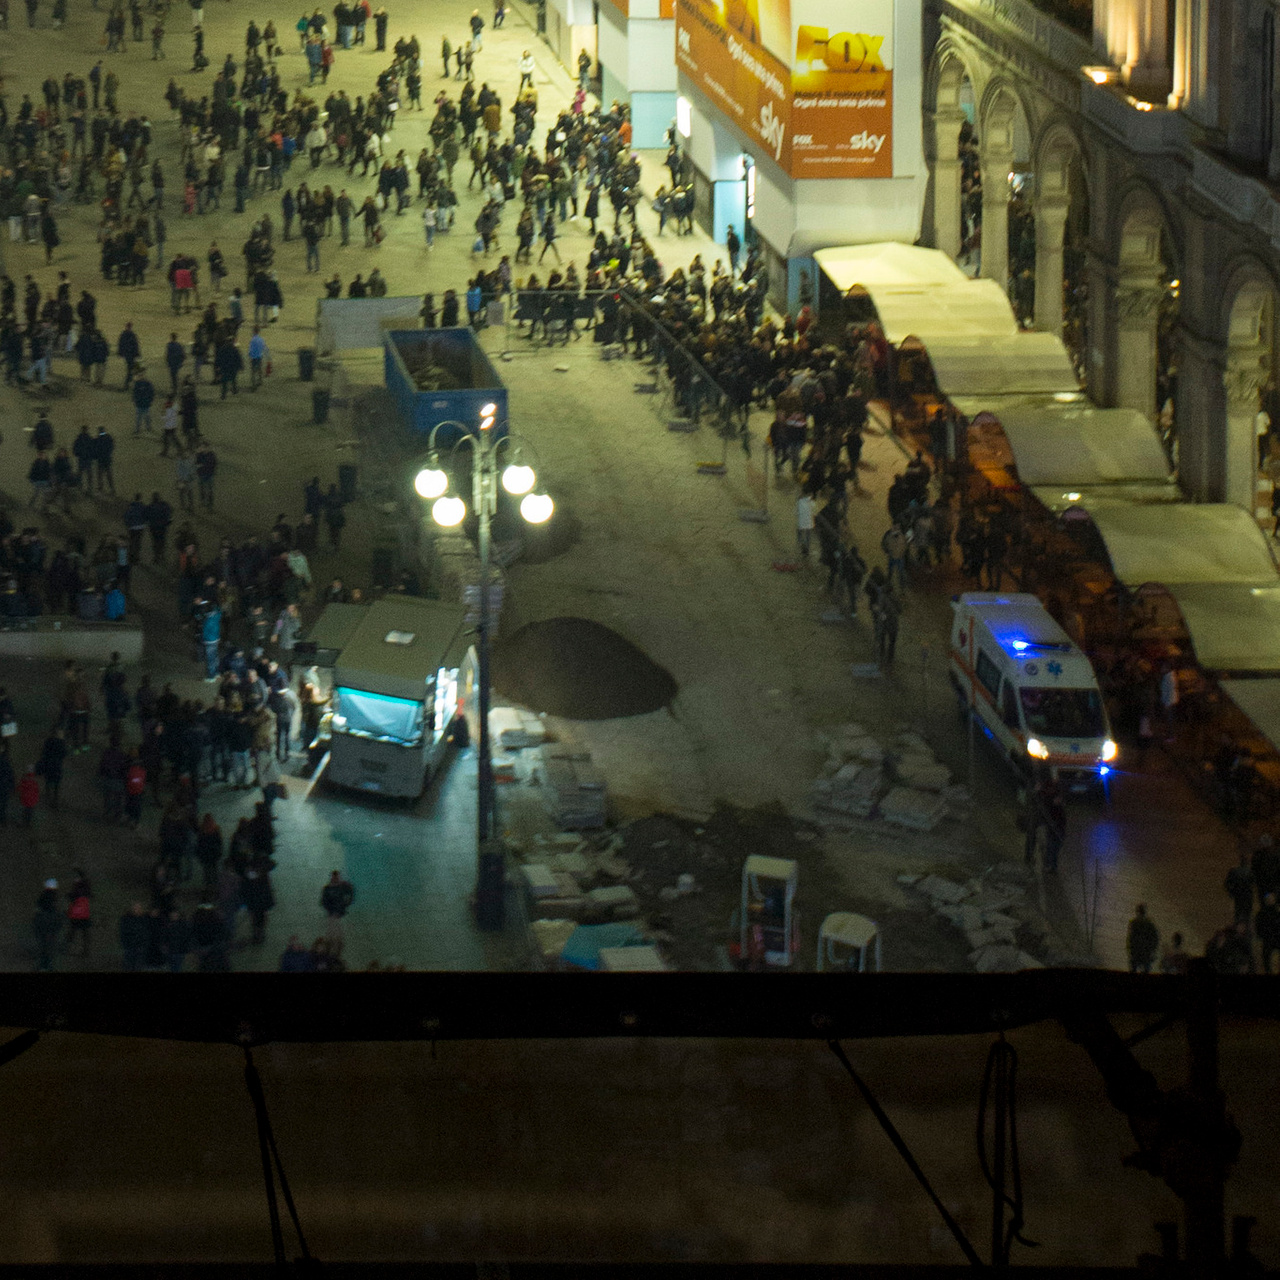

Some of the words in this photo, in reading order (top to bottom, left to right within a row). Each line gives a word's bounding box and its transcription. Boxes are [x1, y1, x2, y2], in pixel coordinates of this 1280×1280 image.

[795, 24, 886, 74] FOX
[793, 97, 818, 109] Ogni
[818, 98, 839, 108] sera
[839, 98, 857, 107] una
[857, 97, 887, 109] prima
[760, 100, 785, 162] sky
[850, 130, 887, 154] sky
